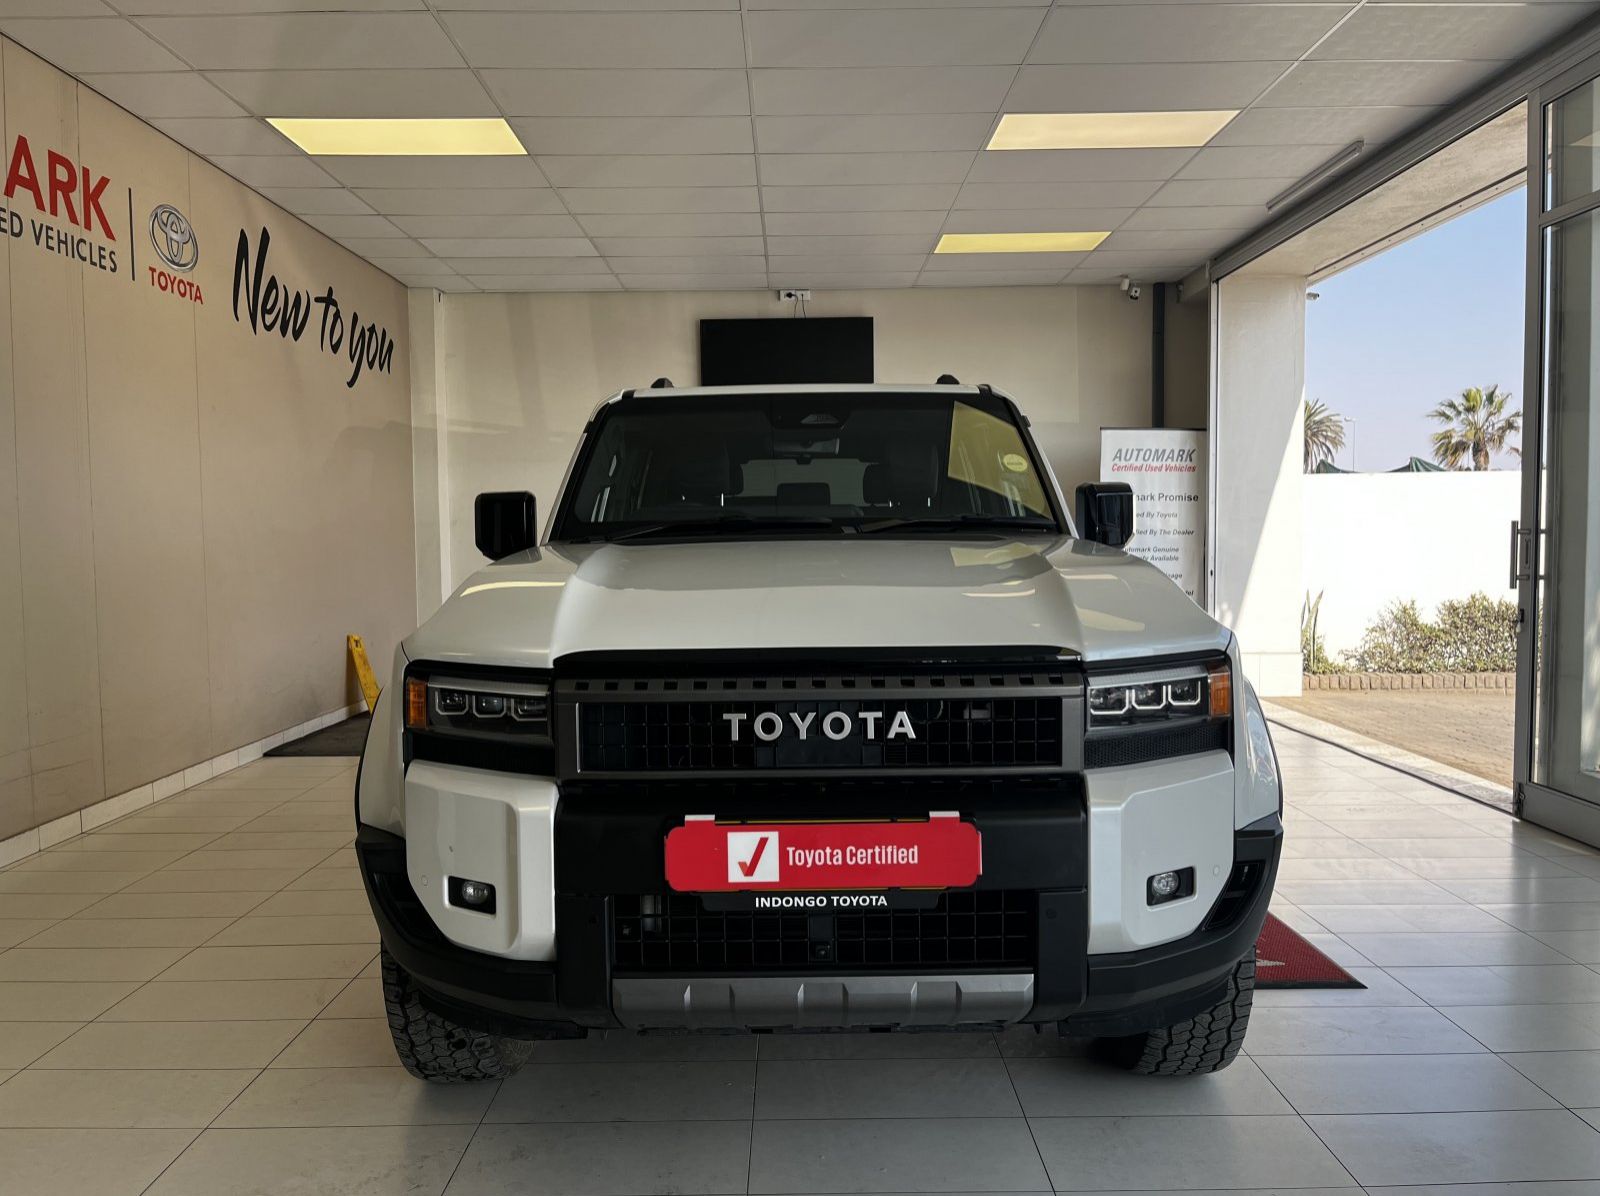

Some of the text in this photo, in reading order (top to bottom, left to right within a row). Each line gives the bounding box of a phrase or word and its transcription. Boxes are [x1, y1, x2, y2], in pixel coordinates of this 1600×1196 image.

[3, 134, 117, 241] ARK
[30, 218, 118, 273] VEHICLES
[148, 266, 204, 305] TOYOTA
[232, 226, 394, 388] New to you
[1111, 463, 1197, 473] Certified Used Vehicles
[1112, 448, 1197, 462] AUTOMARK
[1158, 492, 1199, 502] Promise
[722, 711, 917, 742] TOYOTA
[786, 844, 919, 867] Toyota Certified
[754, 895, 889, 908] INDONGO TOYOTA
